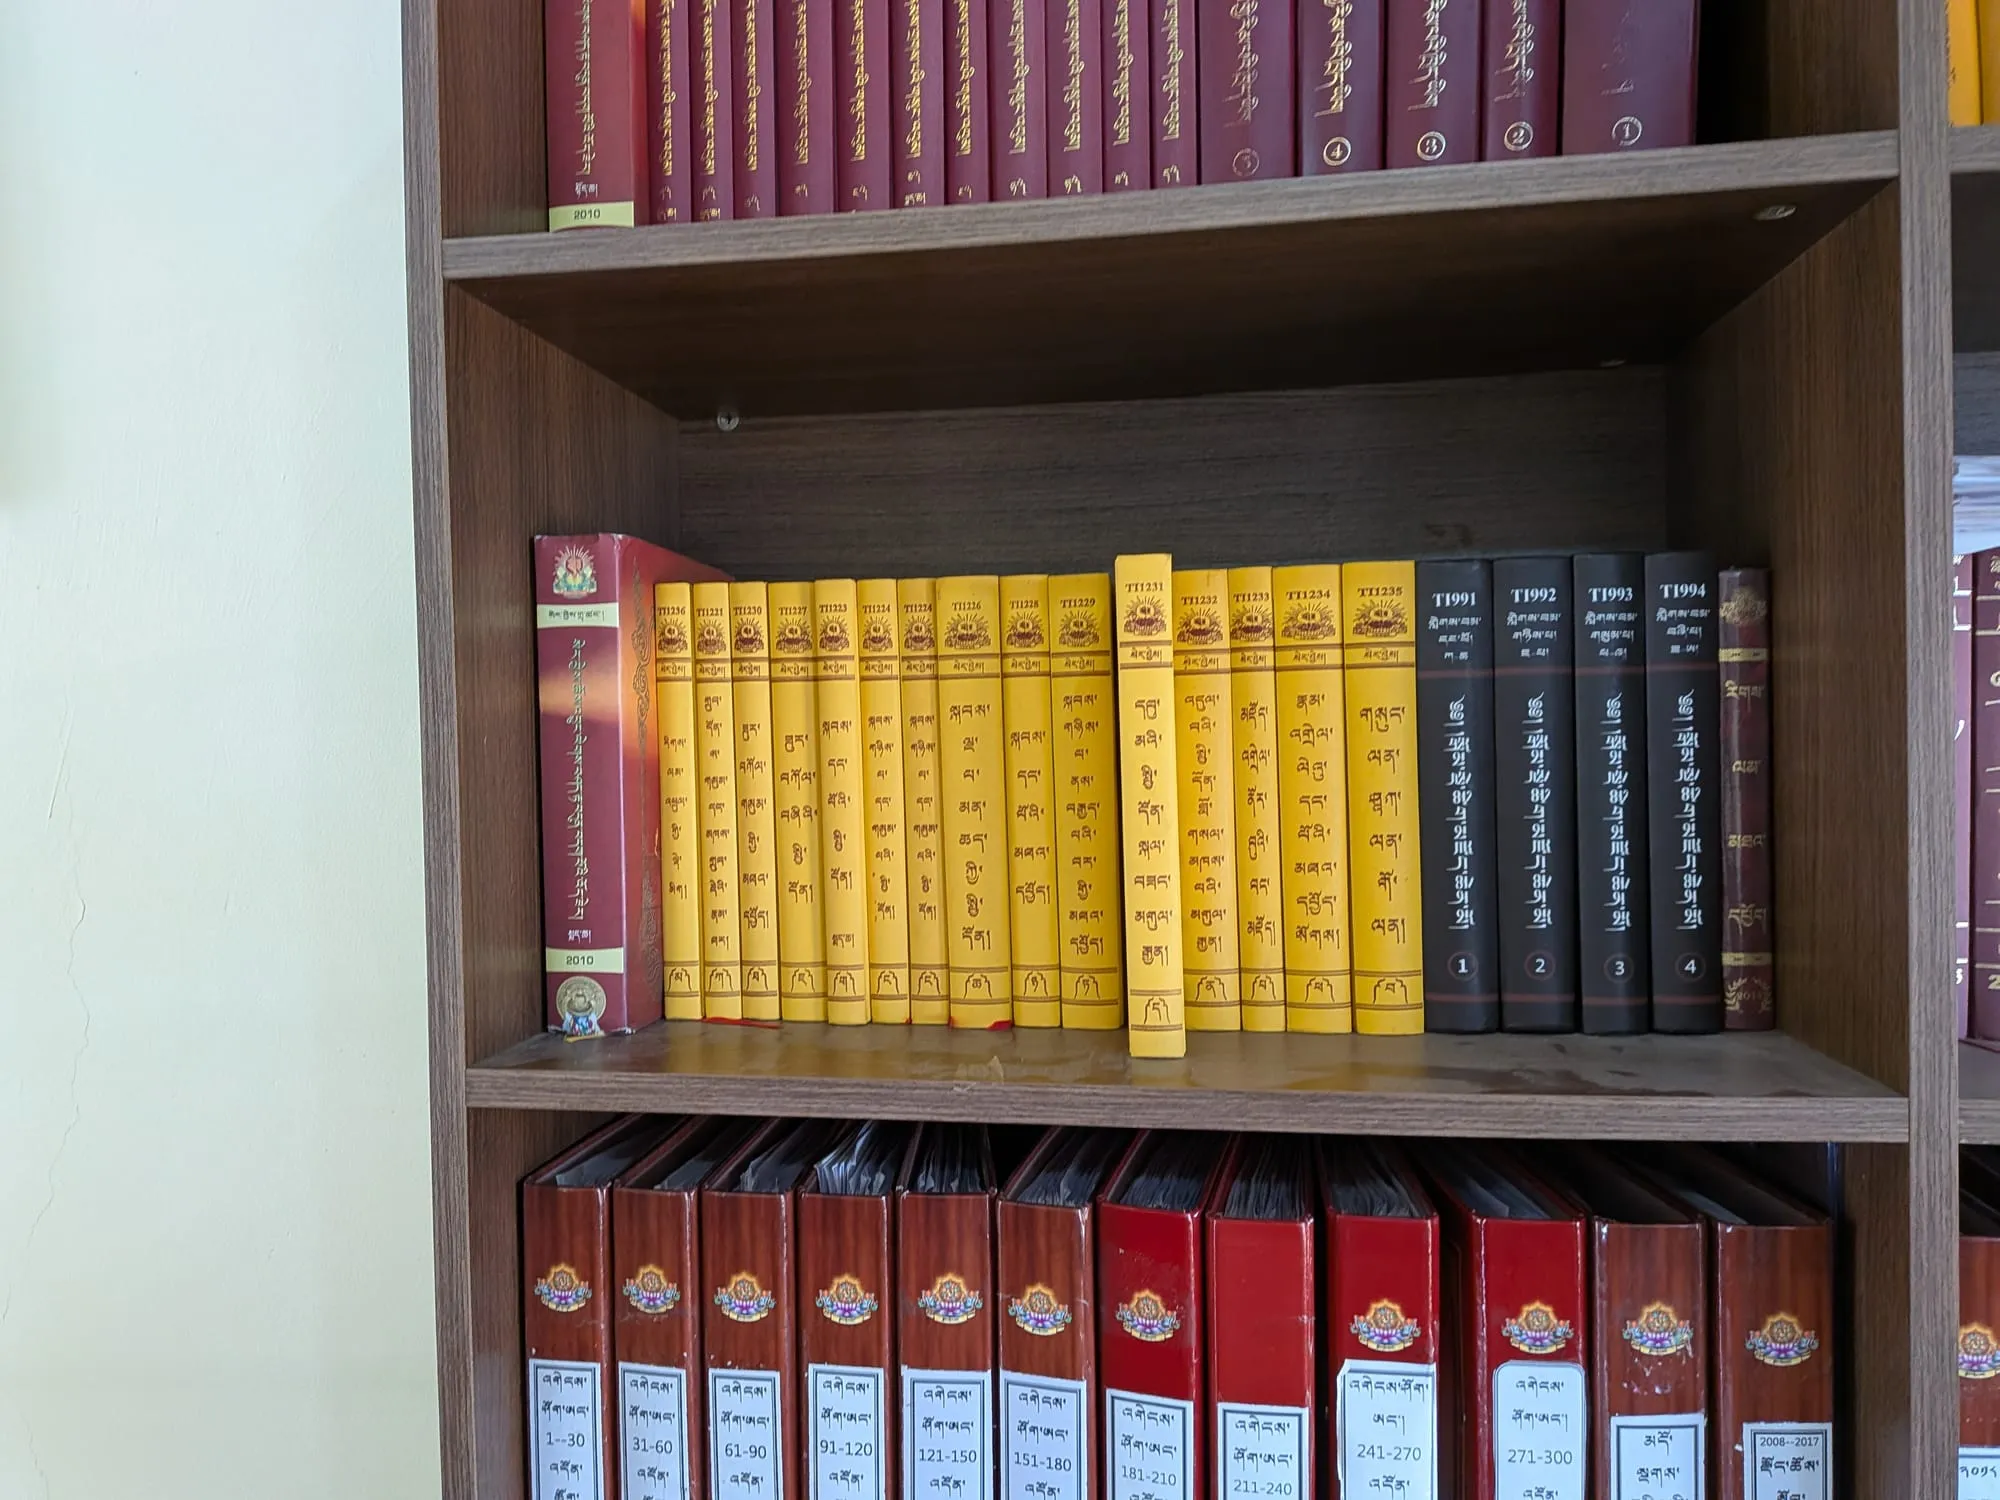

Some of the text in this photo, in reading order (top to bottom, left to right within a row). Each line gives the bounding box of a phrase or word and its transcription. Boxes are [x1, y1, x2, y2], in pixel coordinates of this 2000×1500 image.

[573, 209, 601, 220] 2010
[1125, 582, 1164, 593] TI1231
[1358, 587, 1403, 598] TI1235
[1659, 583, 1707, 600] TI994
[1181, 595, 1218, 606] TI1232
[1233, 592, 1270, 603] TI1233
[1286, 590, 1331, 601] TI1234
[1432, 591, 1477, 608] TI991
[1510, 587, 1558, 605] TI992
[1588, 587, 1634, 604] TI993
[952, 601, 981, 612] TI1226
[1009, 599, 1039, 610] TI1228
[1060, 598, 1095, 609] TI1229
[566, 956, 594, 966] 2010
[1457, 959, 1469, 974] 1
[1534, 958, 1546, 973] 2
[1613, 961, 1624, 975] 3
[1685, 960, 1696, 973] 4
[633, 1437, 673, 1454] 31-60
[725, 1443, 767, 1459] 61-90
[820, 1440, 873, 1457] 91-120
[1357, 1444, 1421, 1461] 241-270
[919, 1449, 977, 1464] 121-150
[1014, 1452, 1072, 1471] 151-180
[1508, 1449, 1573, 1465] 271-300
[1122, 1465, 1177, 1486] 181-210
[1234, 1480, 1292, 1496] 211-240
